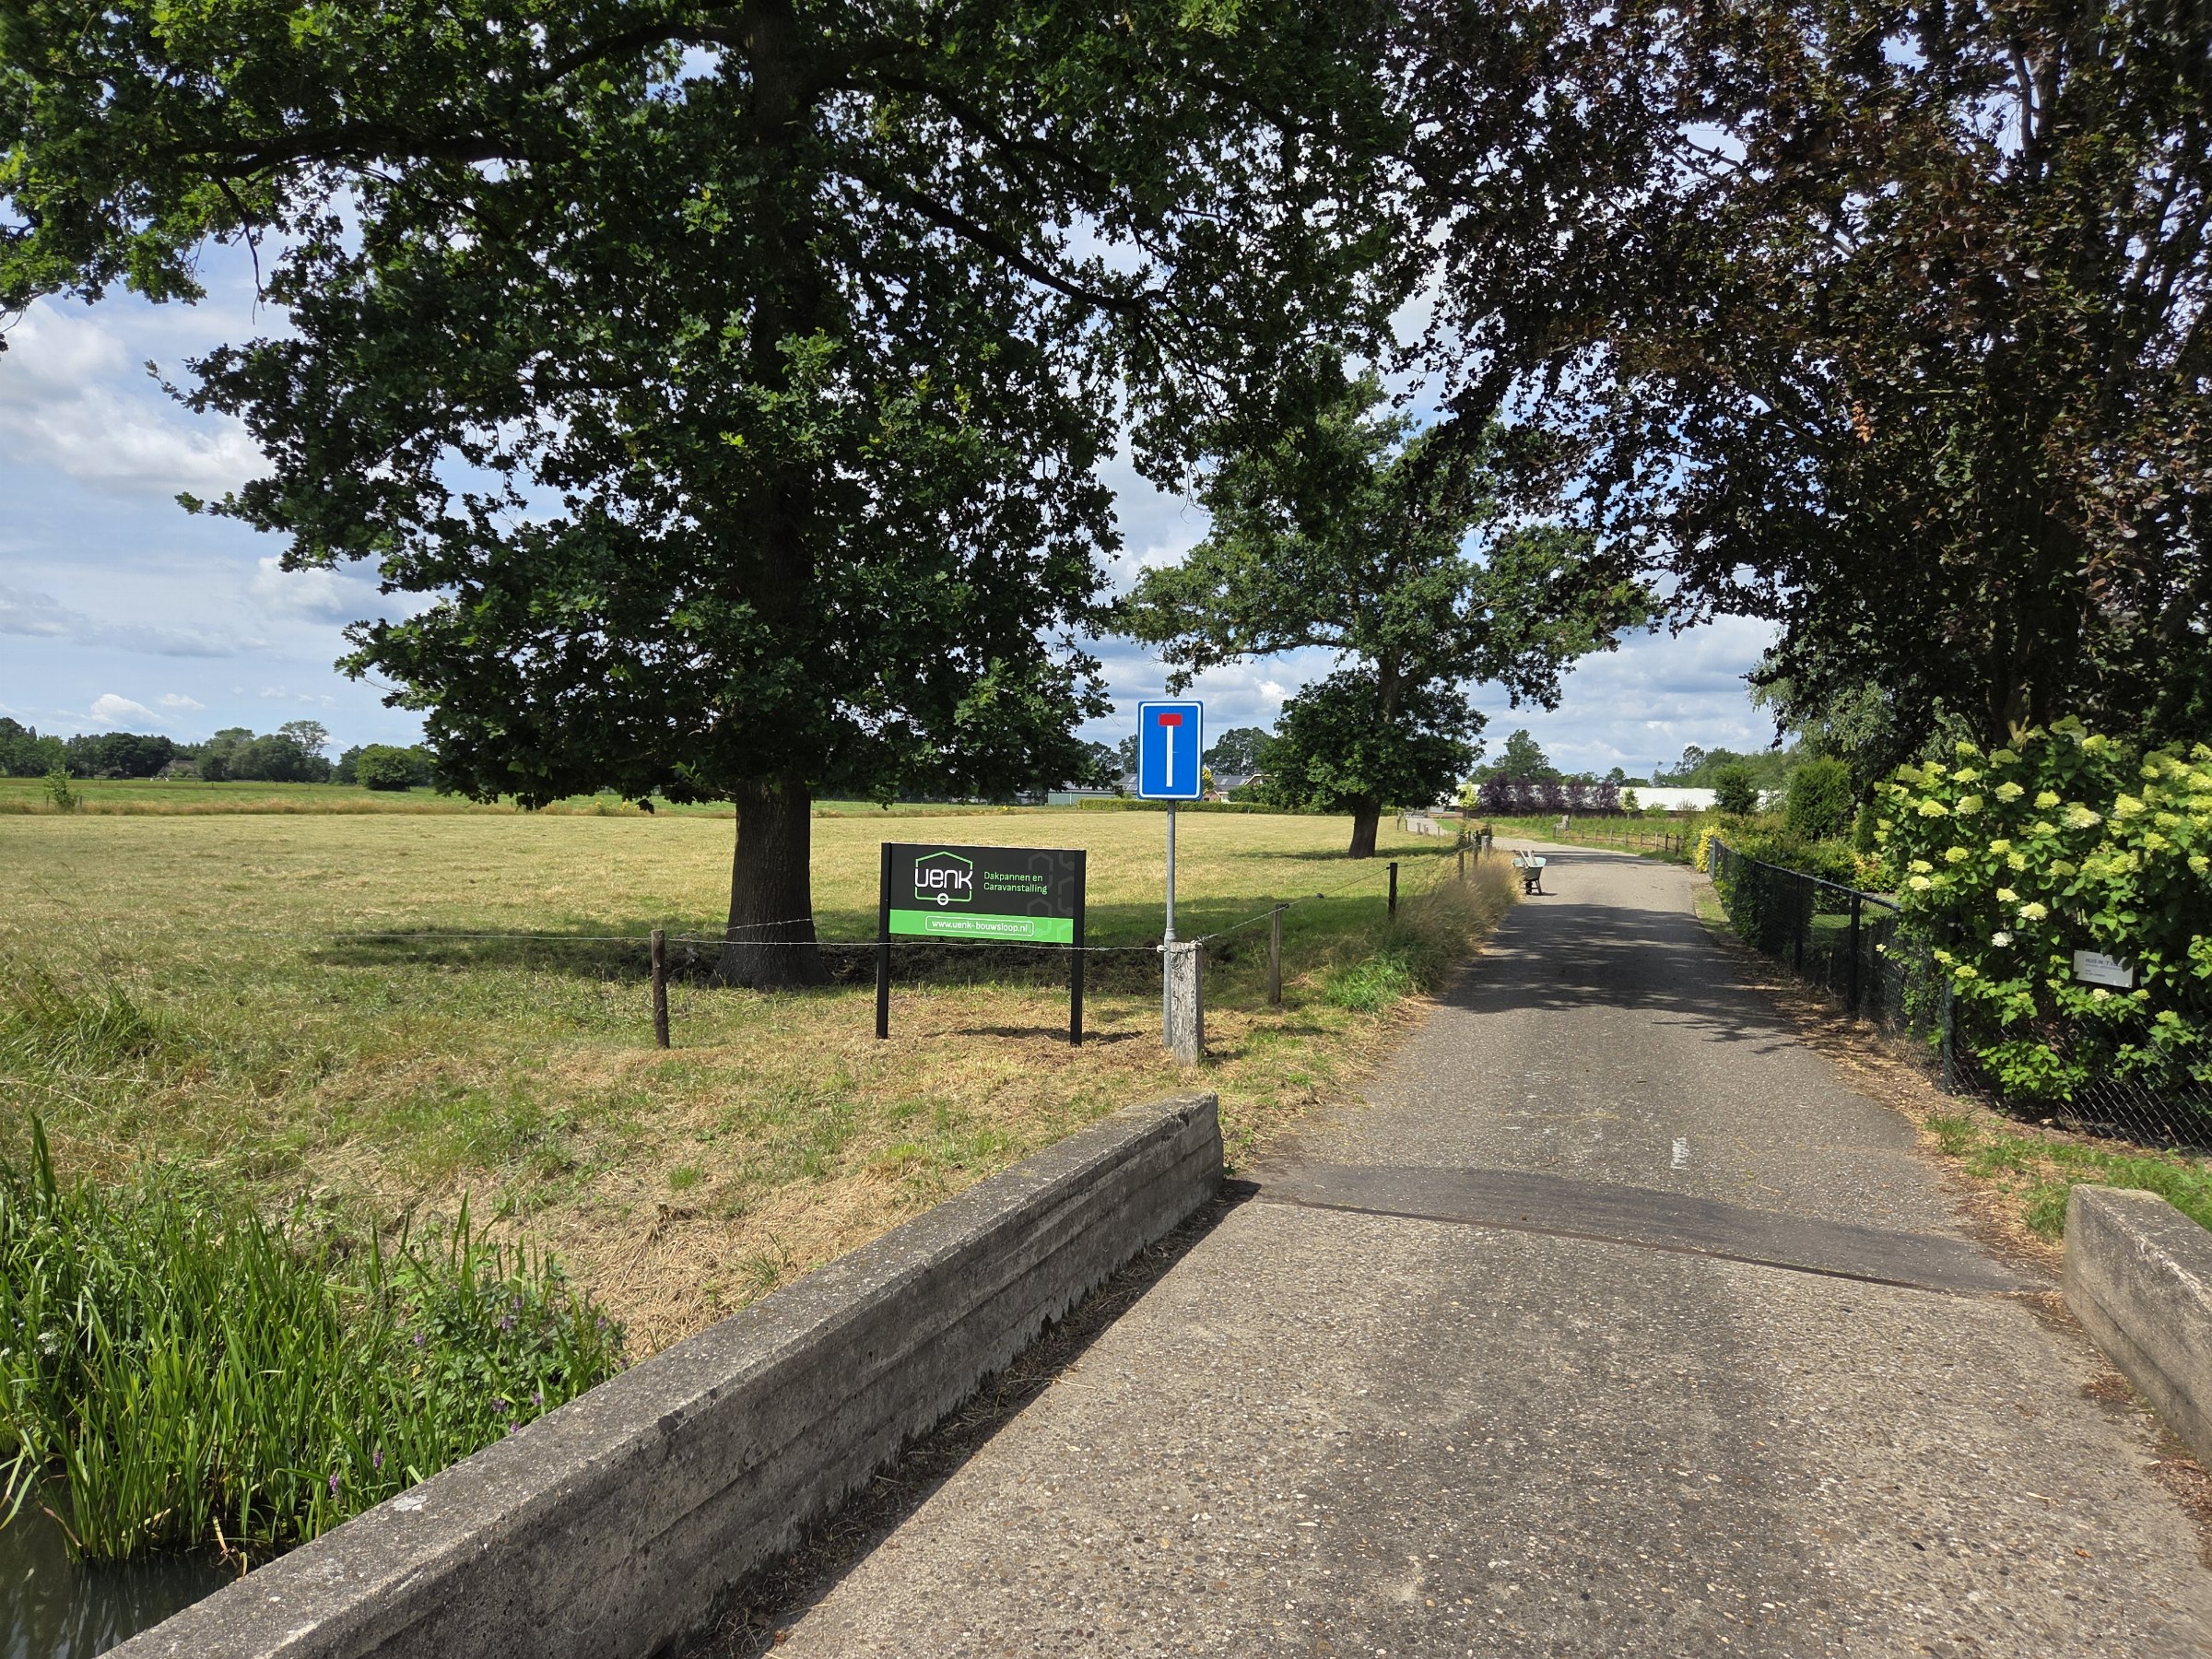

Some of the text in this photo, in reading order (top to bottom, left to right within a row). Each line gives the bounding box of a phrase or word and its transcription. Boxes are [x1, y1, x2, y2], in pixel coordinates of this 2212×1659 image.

[983, 871, 1030, 882] Dakpannen
[983, 882, 1048, 895] Caravanstalling
[932, 921, 1028, 933] www.uenk-bouwsloop.nl
